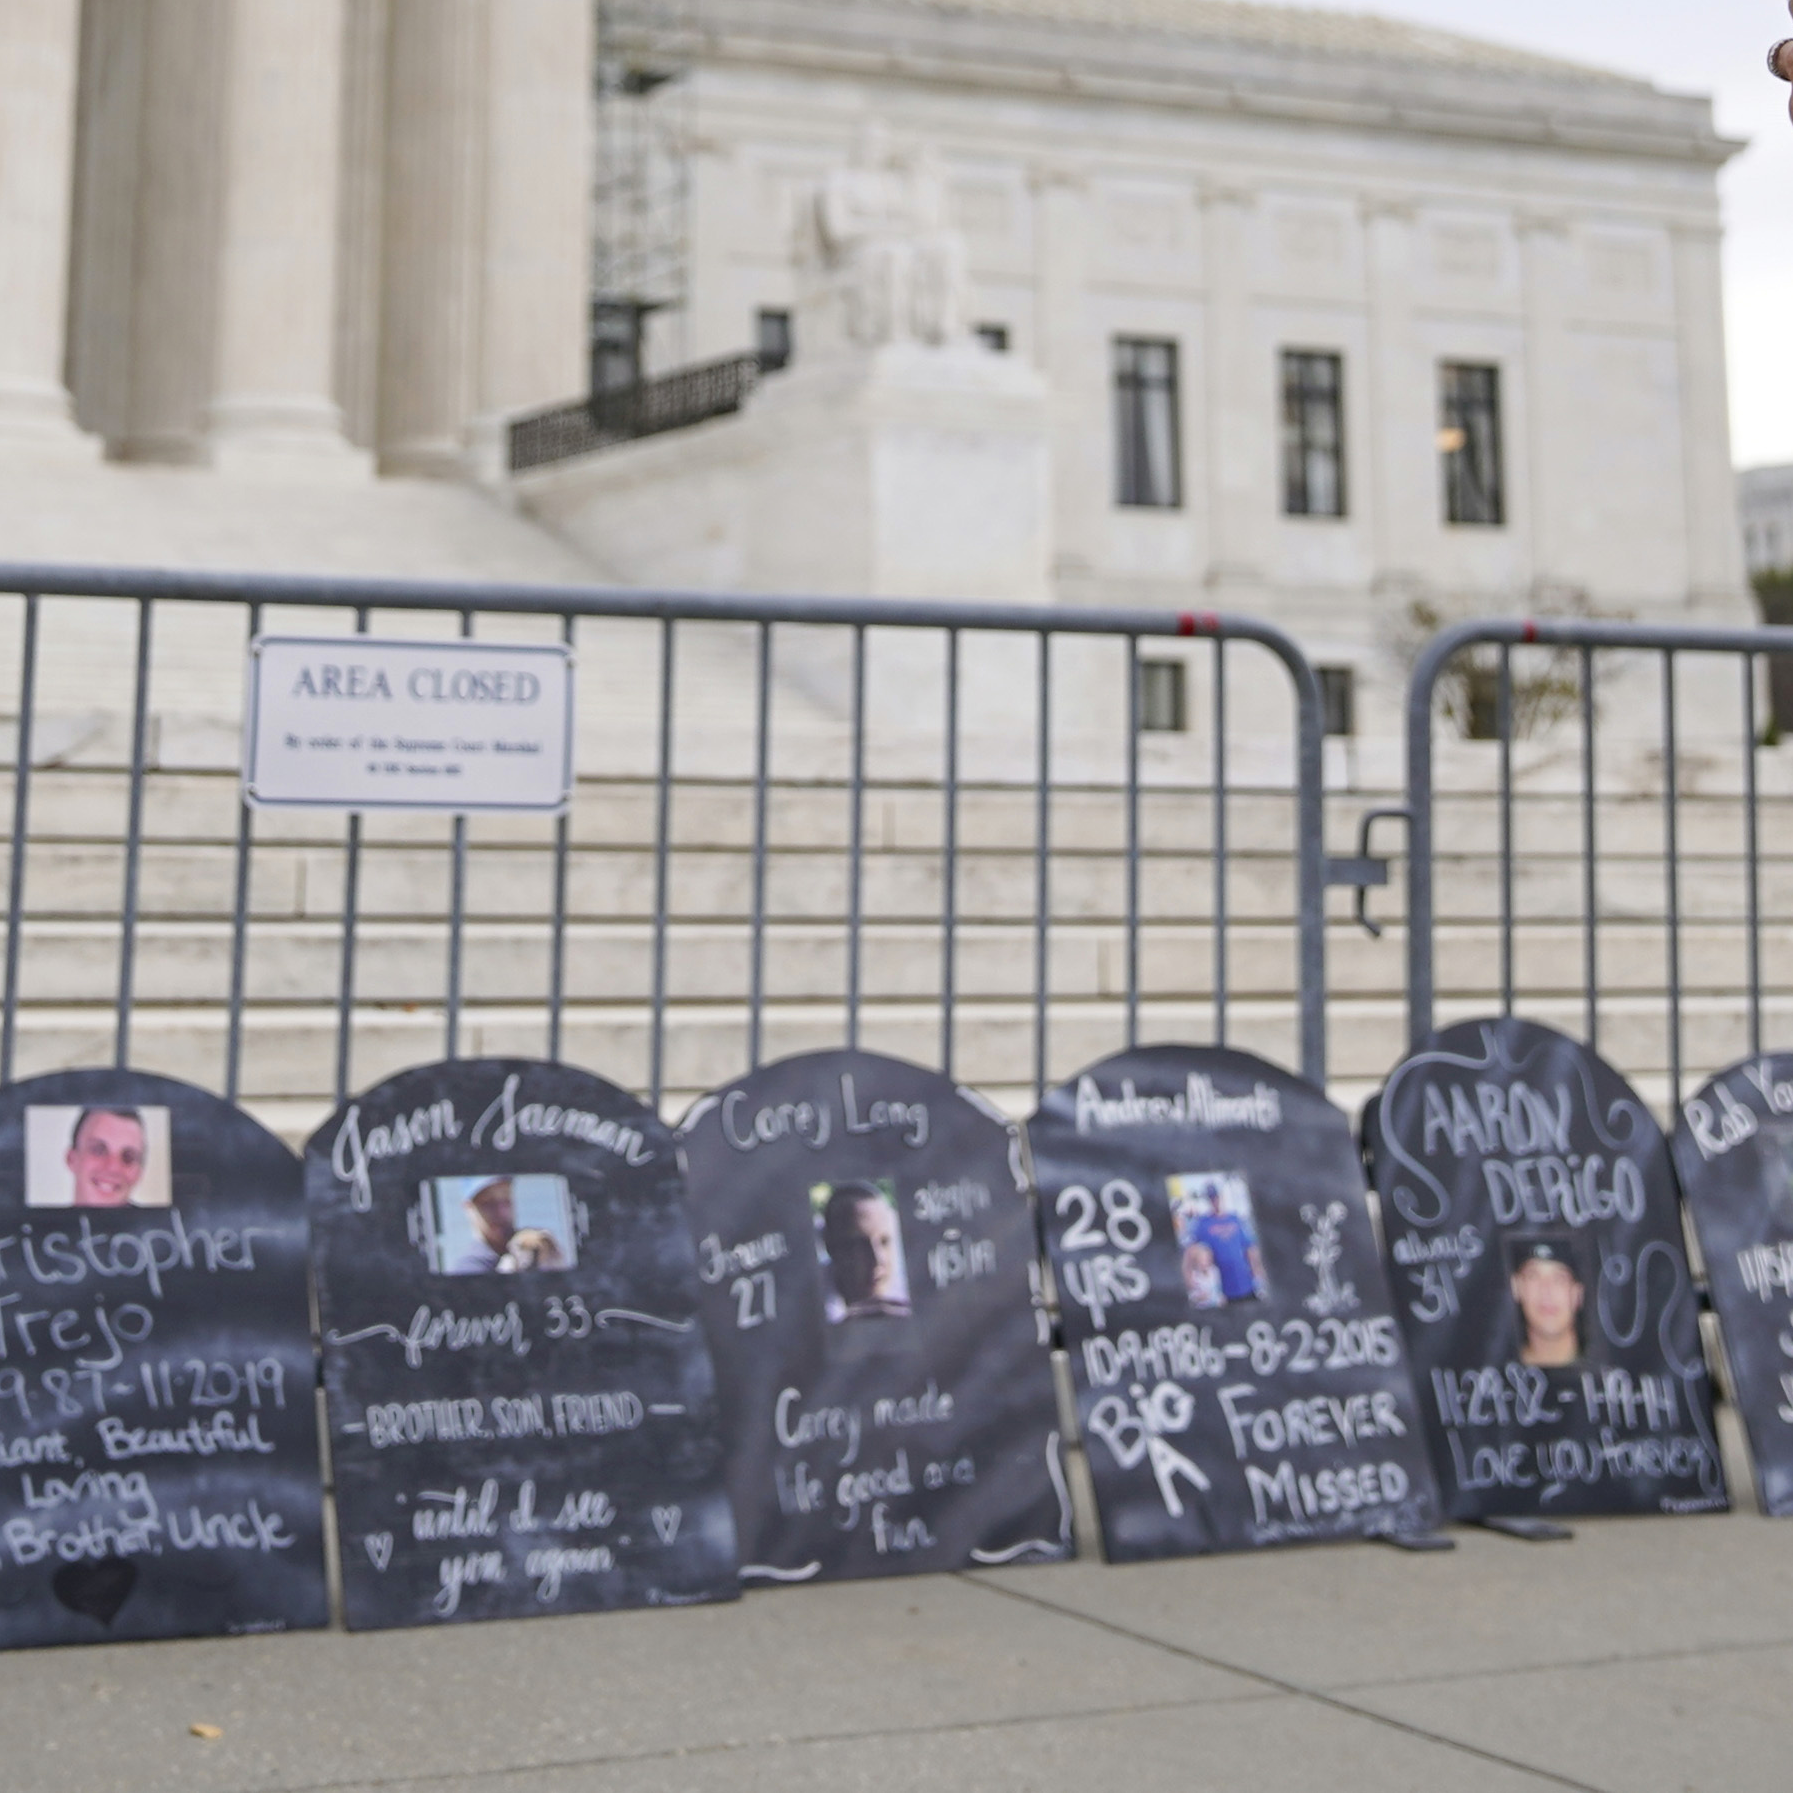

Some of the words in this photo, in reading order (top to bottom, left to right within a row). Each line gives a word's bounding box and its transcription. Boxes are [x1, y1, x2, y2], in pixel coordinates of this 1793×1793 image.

[291, 663, 393, 700] AREA
[406, 667, 542, 704] CLOSED
[1421, 1079, 1572, 1157] AARON
[1682, 1080, 1759, 1162] Rob
[332, 1099, 464, 1212] Jason
[1055, 1177, 1152, 1254] 28
[404, 1300, 532, 1370] forever
[543, 1294, 593, 1339] 33
[728, 1268, 778, 1331] 27
[96, 1410, 276, 1460] Beautiful
[550, 1390, 644, 1437] FRIEND
[873, 1375, 955, 1428] made
[1216, 1382, 1408, 1461] FOREVER
[166, 1498, 297, 1553] Uncle
[1244, 1460, 1409, 1527] MISSED
